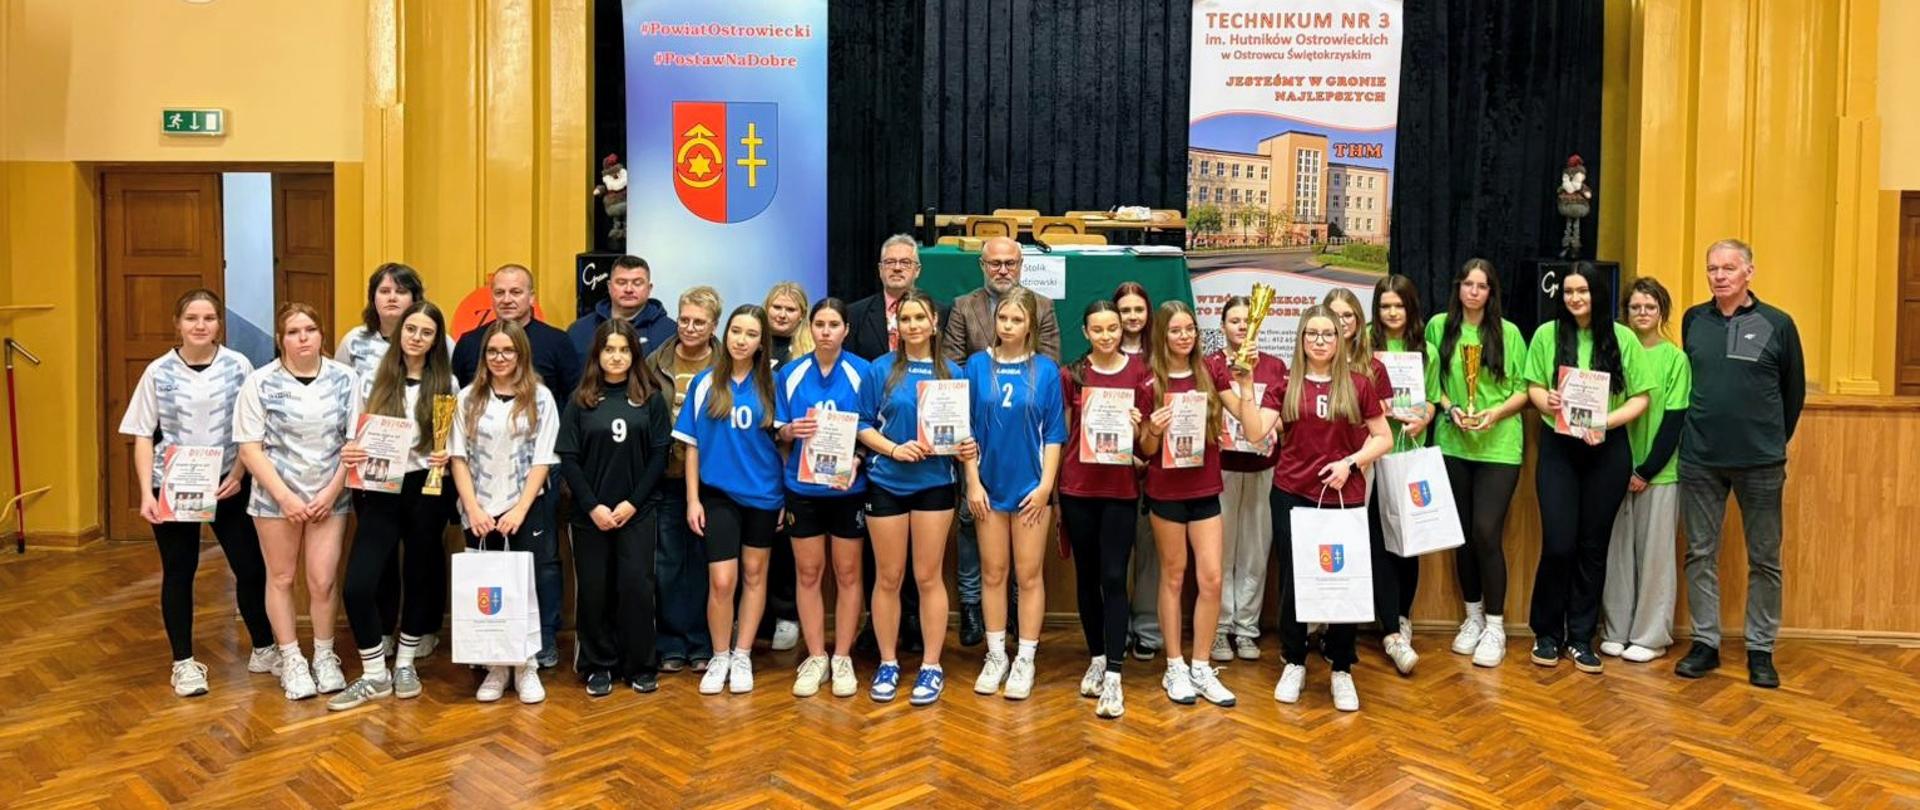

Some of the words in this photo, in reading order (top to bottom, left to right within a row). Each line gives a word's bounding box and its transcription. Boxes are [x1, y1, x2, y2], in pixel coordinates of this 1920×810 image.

[1206, 13, 1332, 29] TECHNIKUM
[1341, 13, 1371, 29] NR
[1378, 13, 1391, 29] 3
[641, 22, 811, 37] #PowiatOstrowiecki
[1205, 34, 1226, 45] im.
[1230, 33, 1292, 45] Hutników
[1296, 33, 1389, 45] Ostrowieckich
[654, 53, 797, 68] #PostawNaDobre
[1221, 52, 1231, 60] w
[1233, 50, 1285, 60] Ostrowcu
[1287, 48, 1372, 62] Świętokrzyskim
[1226, 74, 1305, 87] JESTEŚMY
[1309, 77, 1323, 86] W
[1326, 77, 1387, 86] GRONIE
[1274, 92, 1386, 102] NAJLEPSZYCH
[1333, 143, 1384, 159] THM
[1023, 263, 1046, 272] Stolik
[1196, 293, 1233, 304] WYBÓ
[1196, 307, 1213, 315] TO
[1266, 307, 1302, 316] DOBR
[1002, 382, 1013, 408] 2
[1316, 394, 1328, 418] 6
[731, 406, 753, 429] 10
[611, 418, 628, 443] 9
